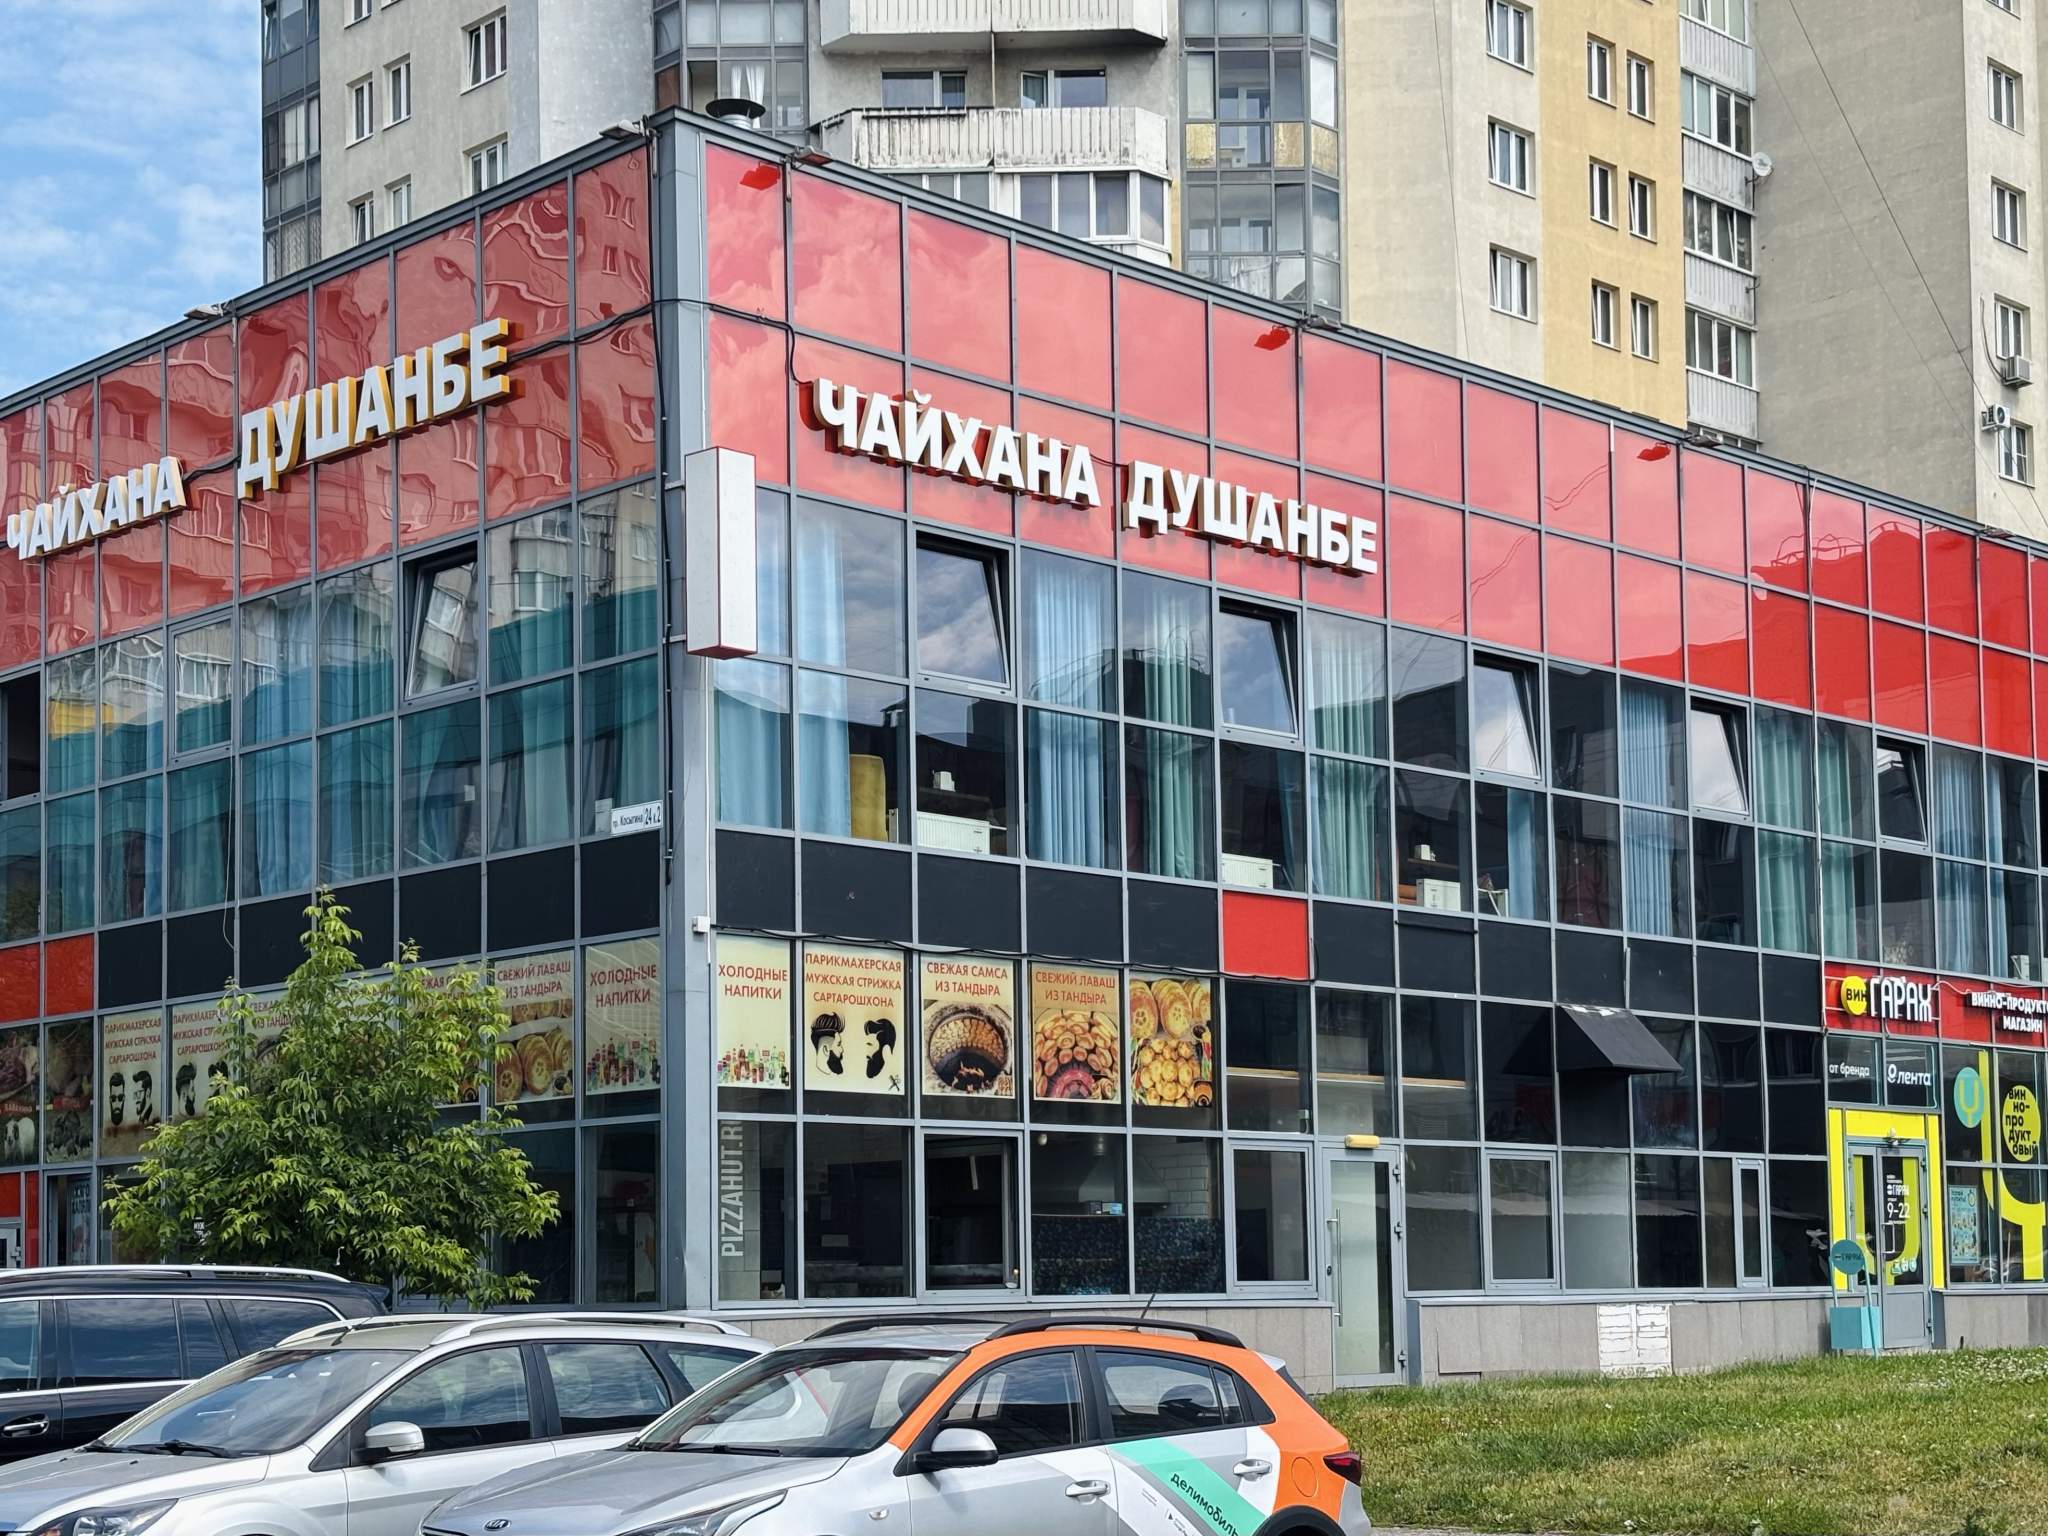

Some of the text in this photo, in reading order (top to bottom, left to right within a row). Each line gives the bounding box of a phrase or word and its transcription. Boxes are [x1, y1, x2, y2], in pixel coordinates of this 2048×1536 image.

[7, 317, 511, 560] ЧАЙХАНА ДУШАНБЕ
[812, 378, 1378, 574] ЧАЙХАНА ДУШАНБЕ
[645, 807, 652, 825] 24
[497, 963, 535, 982] СВЕЖИЙ
[537, 960, 571, 977] ЛАВАШ
[805, 953, 901, 972] ПАРИКМАХЕРСКАЯ
[927, 962, 1008, 979] СВЕЖАЯ САМСА
[590, 964, 657, 986] ХОЛОДНЫЕ
[719, 965, 787, 982] ХОЛОДНЫЕ
[805, 973, 901, 991] МУЖСКАЯ СТРИЖКА
[1035, 971, 1115, 989] СВЕЖИЙ ЛАВАШ
[505, 981, 562, 999] ИЗ ТАНДЫРА
[725, 984, 782, 1000] НАПИТКИ
[935, 980, 1000, 996] ИЗ ТАНДЫРА
[596, 989, 650, 1008] НАПИТКИ
[813, 992, 894, 1008] САРТАРОШХОНА
[1045, 989, 1106, 1006] ИЗ ТАНДЫРА
[1845, 977, 1932, 1022] ВИН ГАРАЖ
[2002, 1015, 2043, 1033] МАГАЗИН
[1829, 1062, 1870, 1078] от бренда
[1897, 1071, 1932, 1087] лента
[1886, 1202, 1911, 1219] 9-22
[1170, 1472, 1241, 1536] делимобиль
